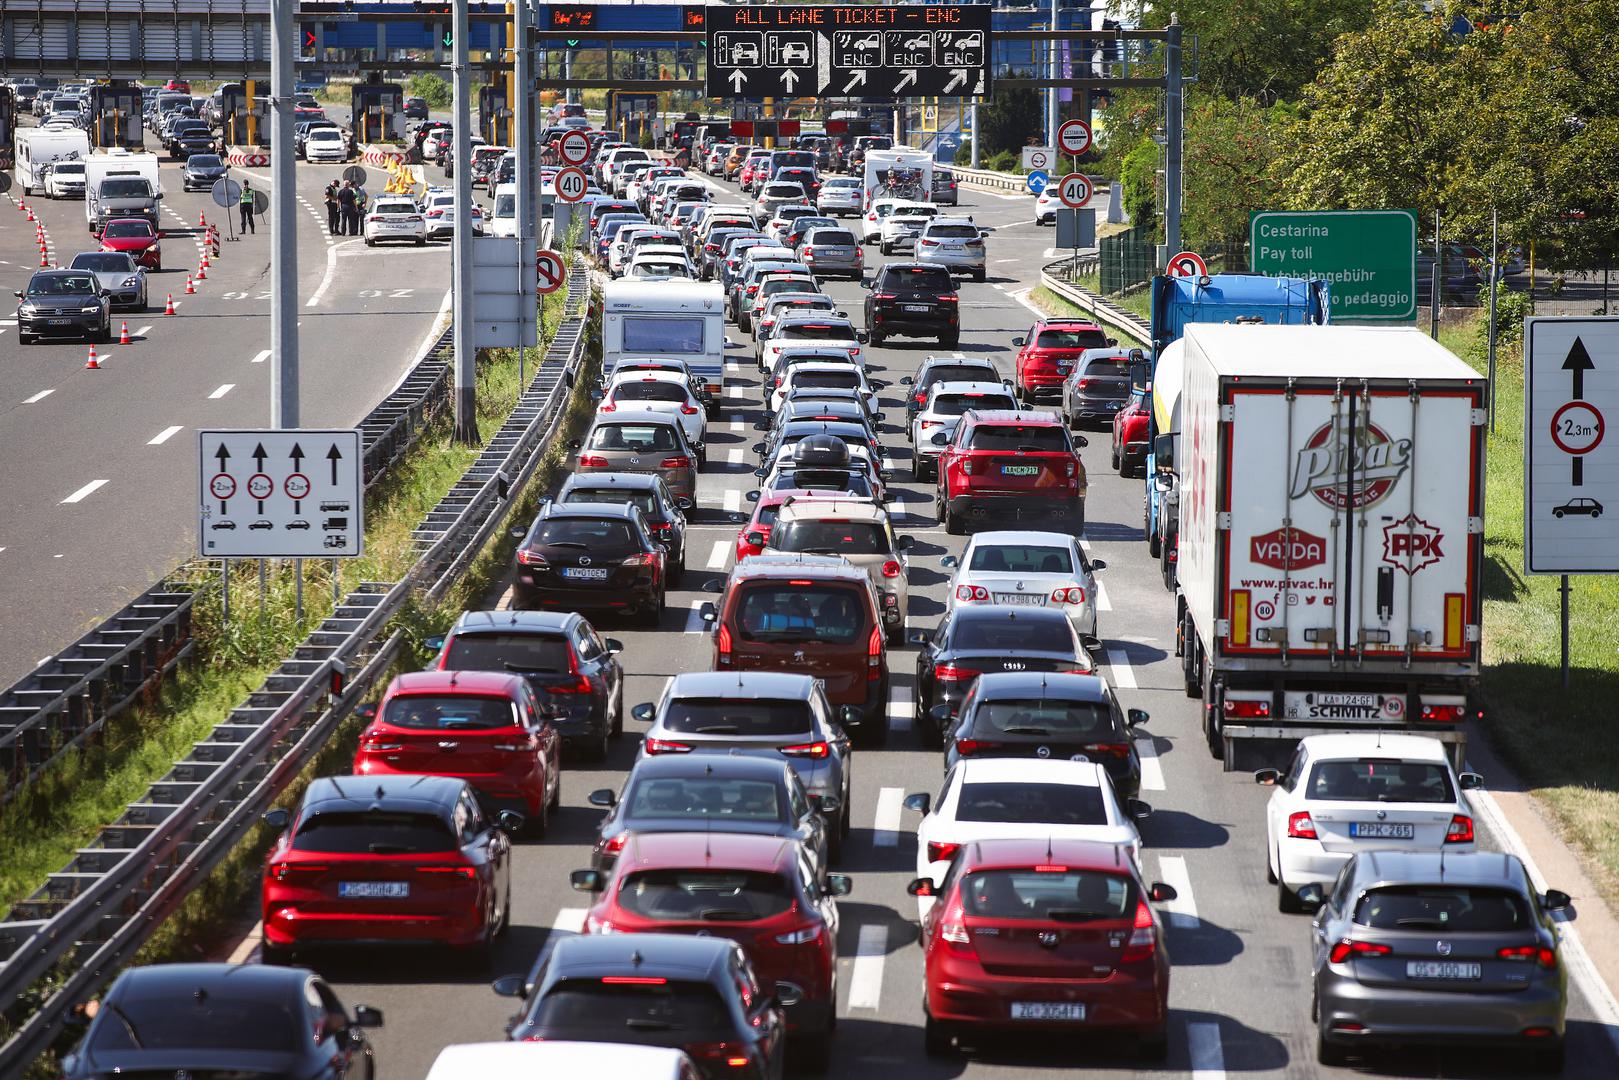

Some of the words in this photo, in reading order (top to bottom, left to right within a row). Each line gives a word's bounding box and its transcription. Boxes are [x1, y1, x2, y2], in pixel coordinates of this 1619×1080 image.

[735, 9, 769, 24] ALL
[778, 9, 824, 24] LANE
[833, 8, 898, 23] TICKET
[926, 8, 961, 23] ENC
[843, 53, 873, 65] ENC
[893, 53, 924, 65] ENC
[944, 53, 975, 65] ENC
[562, 176, 581, 193] 40
[1066, 183, 1085, 200] 40
[1260, 224, 1329, 238] Cestarina
[1260, 246, 1286, 263] Pay
[1291, 246, 1313, 259] toll
[1345, 290, 1409, 307] pedaggio
[1391, 533, 1444, 557] PPK
[1240, 577, 1334, 592] www.pivac.hr
[1259, 606, 1271, 615] 80
[1324, 695, 1335, 704] KA
[1288, 708, 1298, 719] HR
[1309, 706, 1380, 719] SCHMITZ
[1359, 823, 1383, 836] PPK
[1388, 824, 1410, 837] 265
